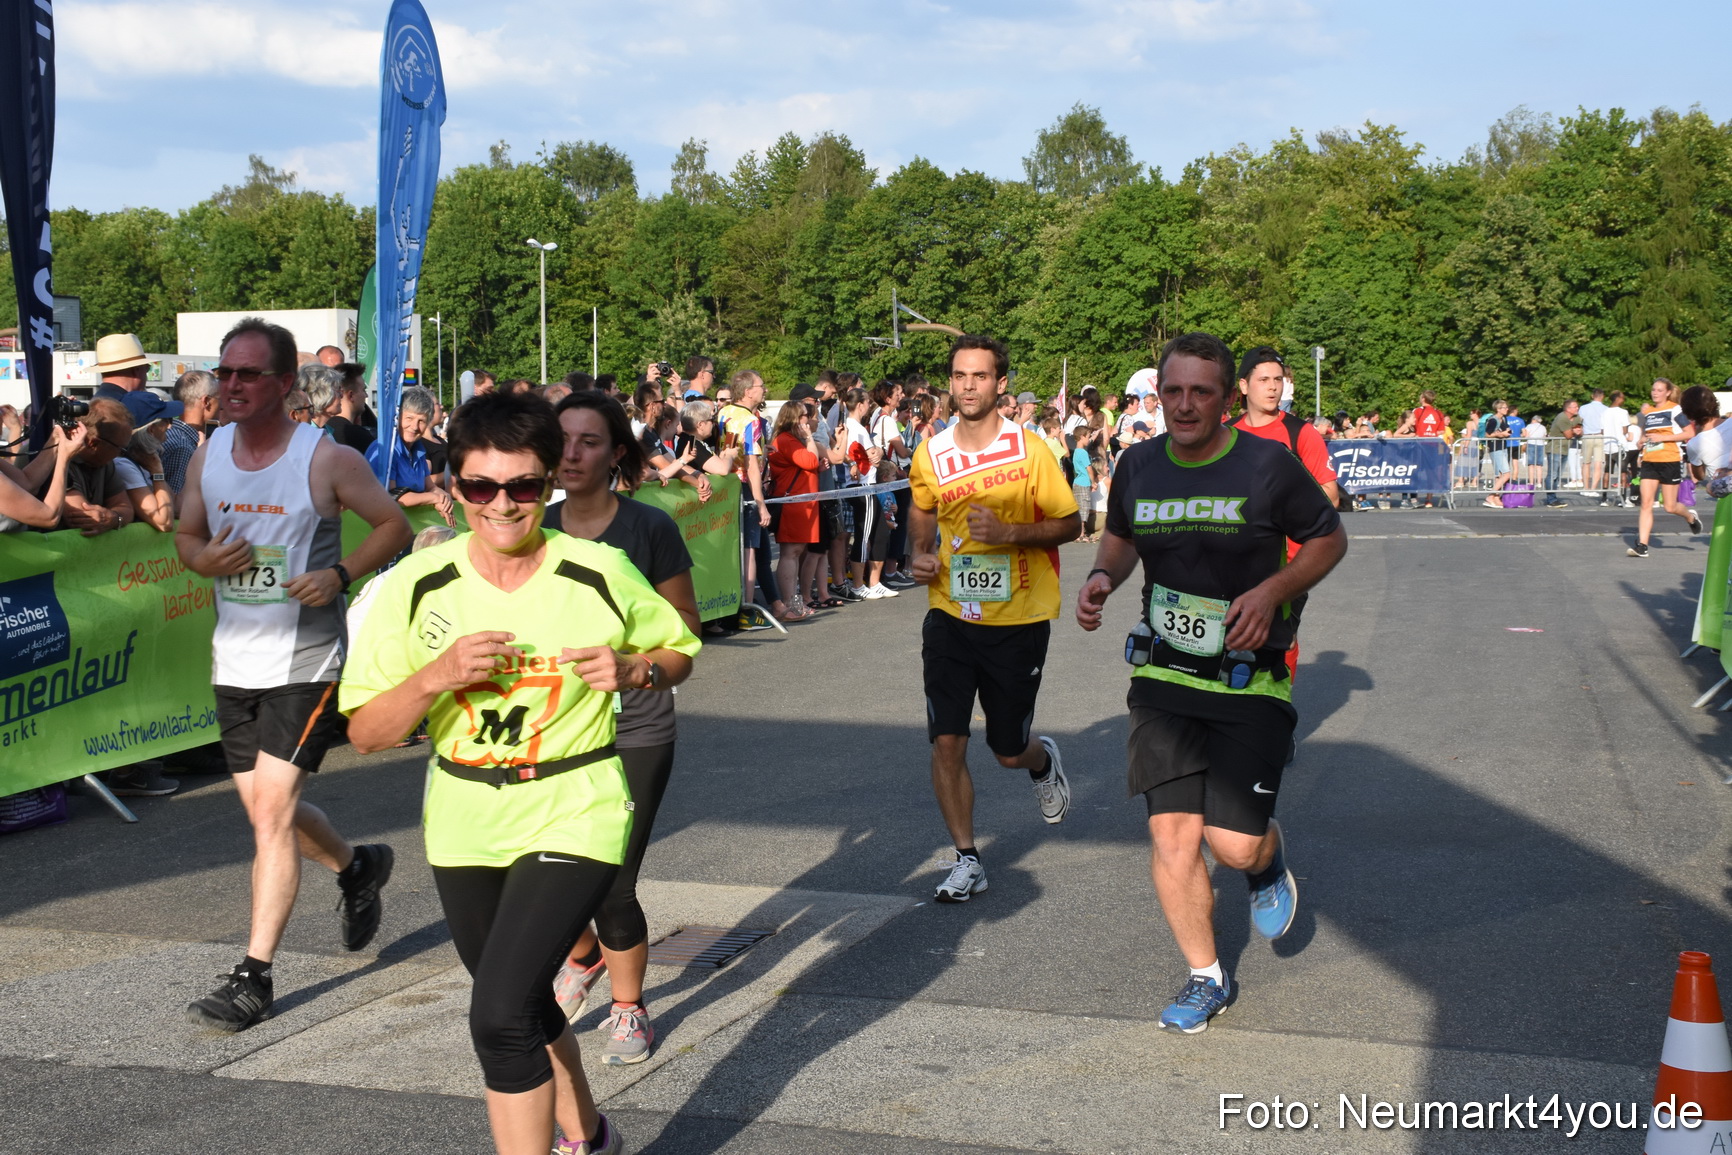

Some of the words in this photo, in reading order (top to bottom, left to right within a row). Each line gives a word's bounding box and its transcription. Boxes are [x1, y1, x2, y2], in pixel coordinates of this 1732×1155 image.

[1337, 461, 1418, 478] Fischer
[941, 481, 978, 505] MAX
[983, 467, 1029, 489] BÖGL
[1344, 478, 1411, 487] AUTOMOBILE
[234, 504, 289, 515] KLEBL
[1135, 499, 1242, 522] BOCK
[1134, 526, 1160, 537] inspired
[1161, 525, 1173, 535] by
[1174, 524, 1198, 533] smart
[1199, 525, 1239, 536] concepts
[957, 571, 1002, 588] 1692
[6, 620, 51, 639] AUTOMOBILE
[1163, 610, 1206, 639] 336
[83, 704, 219, 756] www.firmenlauf-ob
[473, 705, 530, 747] M
[1709, 1131, 1732, 1155] A
